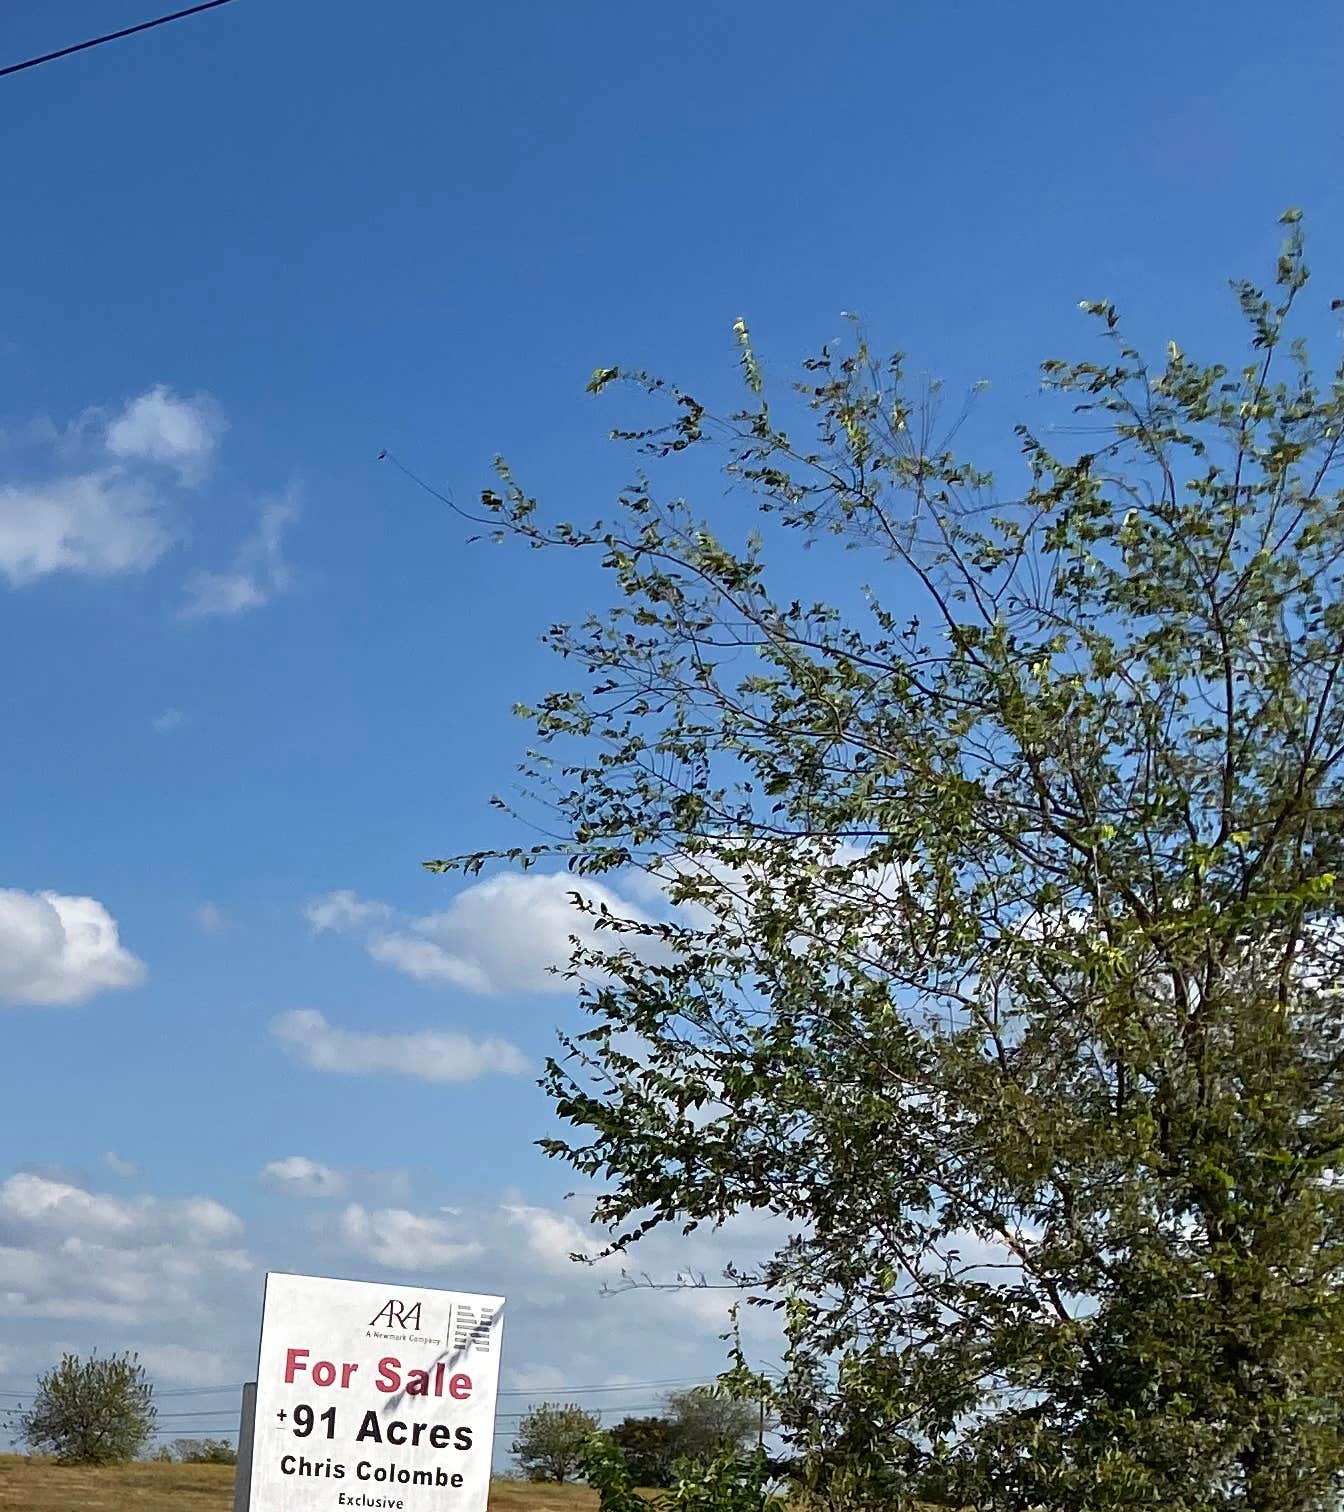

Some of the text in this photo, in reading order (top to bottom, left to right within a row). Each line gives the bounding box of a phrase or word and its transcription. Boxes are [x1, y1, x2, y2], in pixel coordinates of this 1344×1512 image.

[368, 1299, 422, 1331] ARA
[284, 1348, 473, 1400] For Sale
[356, 1410, 473, 1451] Acres
[280, 1455, 464, 1488] Chris Colombe
[338, 1492, 404, 1510] Exclusive
